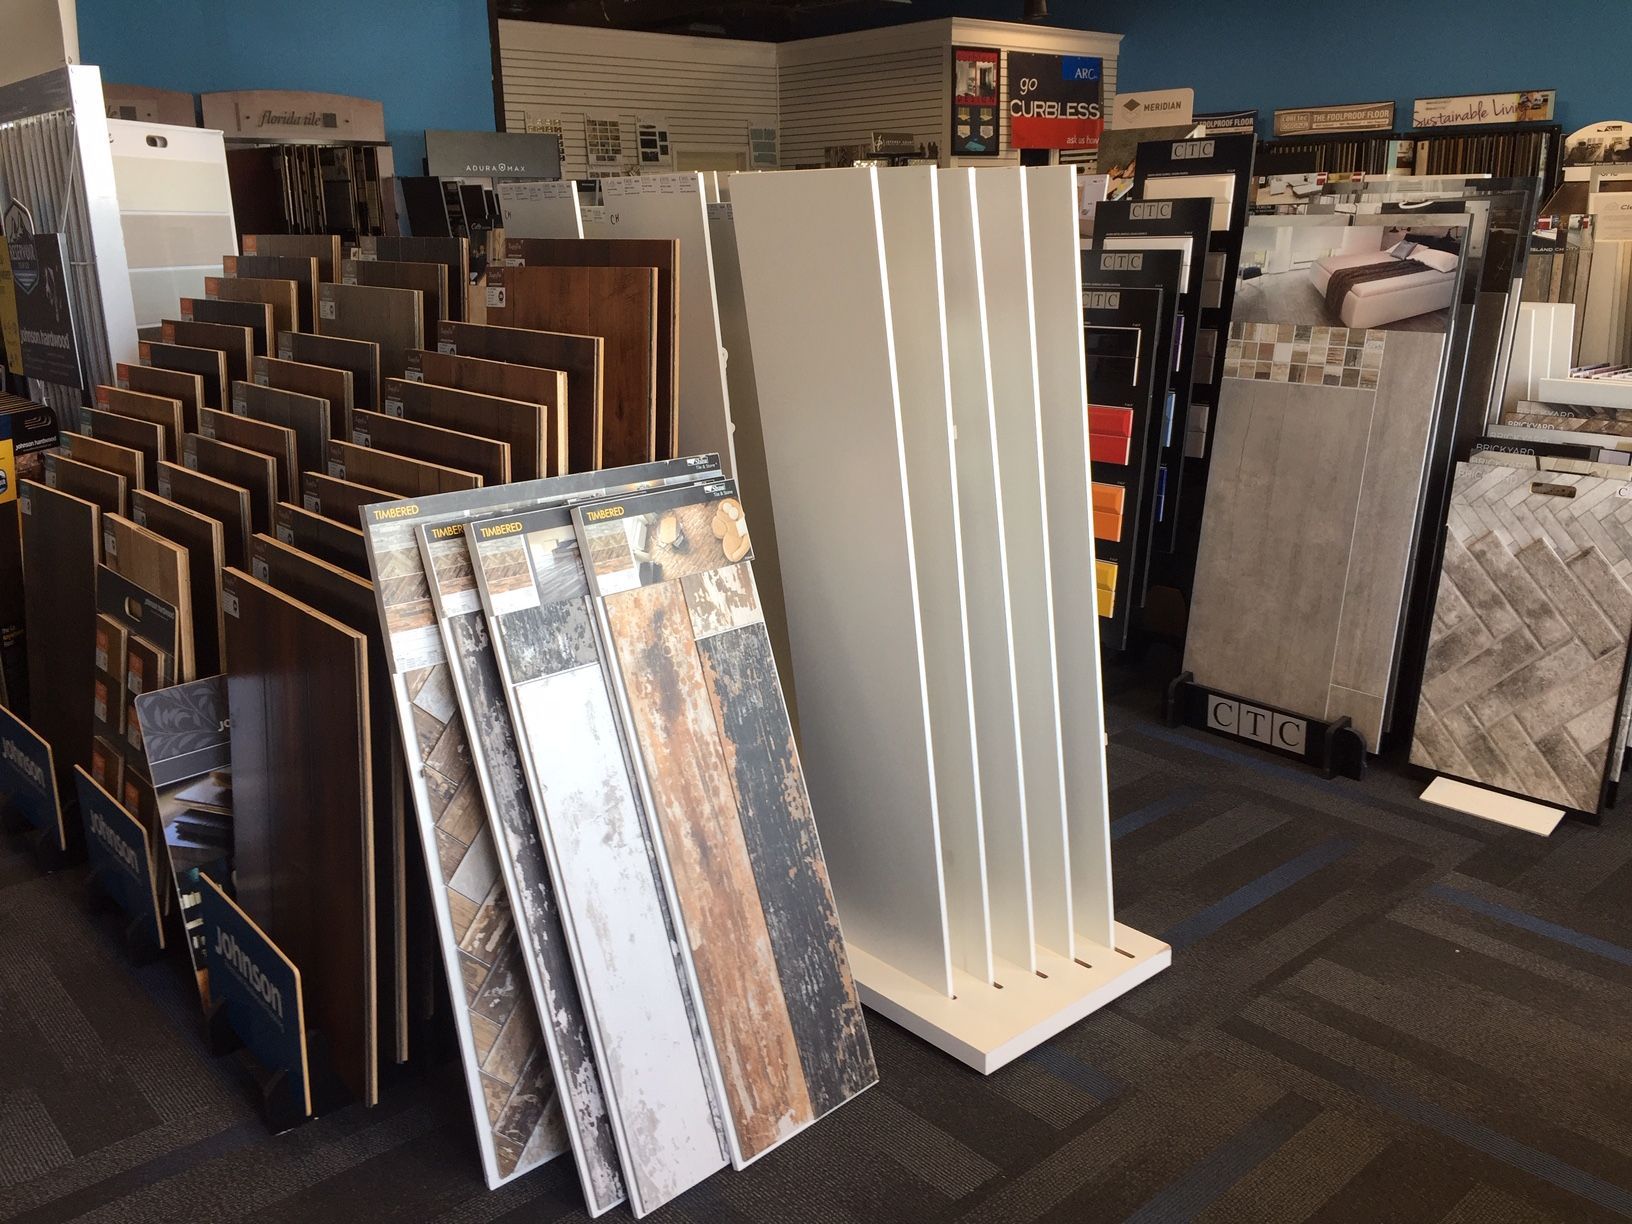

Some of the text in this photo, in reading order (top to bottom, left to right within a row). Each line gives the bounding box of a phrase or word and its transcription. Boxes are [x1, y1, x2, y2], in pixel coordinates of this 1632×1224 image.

[1074, 67, 1096, 79] ARC
[1020, 77, 1038, 95] go
[1009, 99, 1101, 120] CURBLESS
[1143, 101, 1182, 112] MERIDIAN
[1413, 101, 1489, 127] Sustainable
[1493, 99, 1531, 118] Living
[258, 110, 321, 128] florida tile
[1234, 117, 1254, 127] FLOOR
[1313, 109, 1390, 122] THE FOOLPROOF FLOOR
[1066, 134, 1099, 145] ask us how
[1174, 142, 1213, 158] CTC
[466, 163, 526, 173] ADURA MAX
[1132, 203, 1171, 218] CTC
[1103, 254, 1142, 269] CTC
[1476, 443, 1535, 456] BRICKYARD
[373, 505, 420, 520] TIMBERED
[586, 506, 625, 521] TIMBERED
[431, 525, 464, 539] TIMBER
[480, 521, 523, 538] TIMBERED
[1213, 702, 1300, 747] CTC
[90, 809, 140, 875] Johnson
[215, 926, 284, 1019] Johnson
